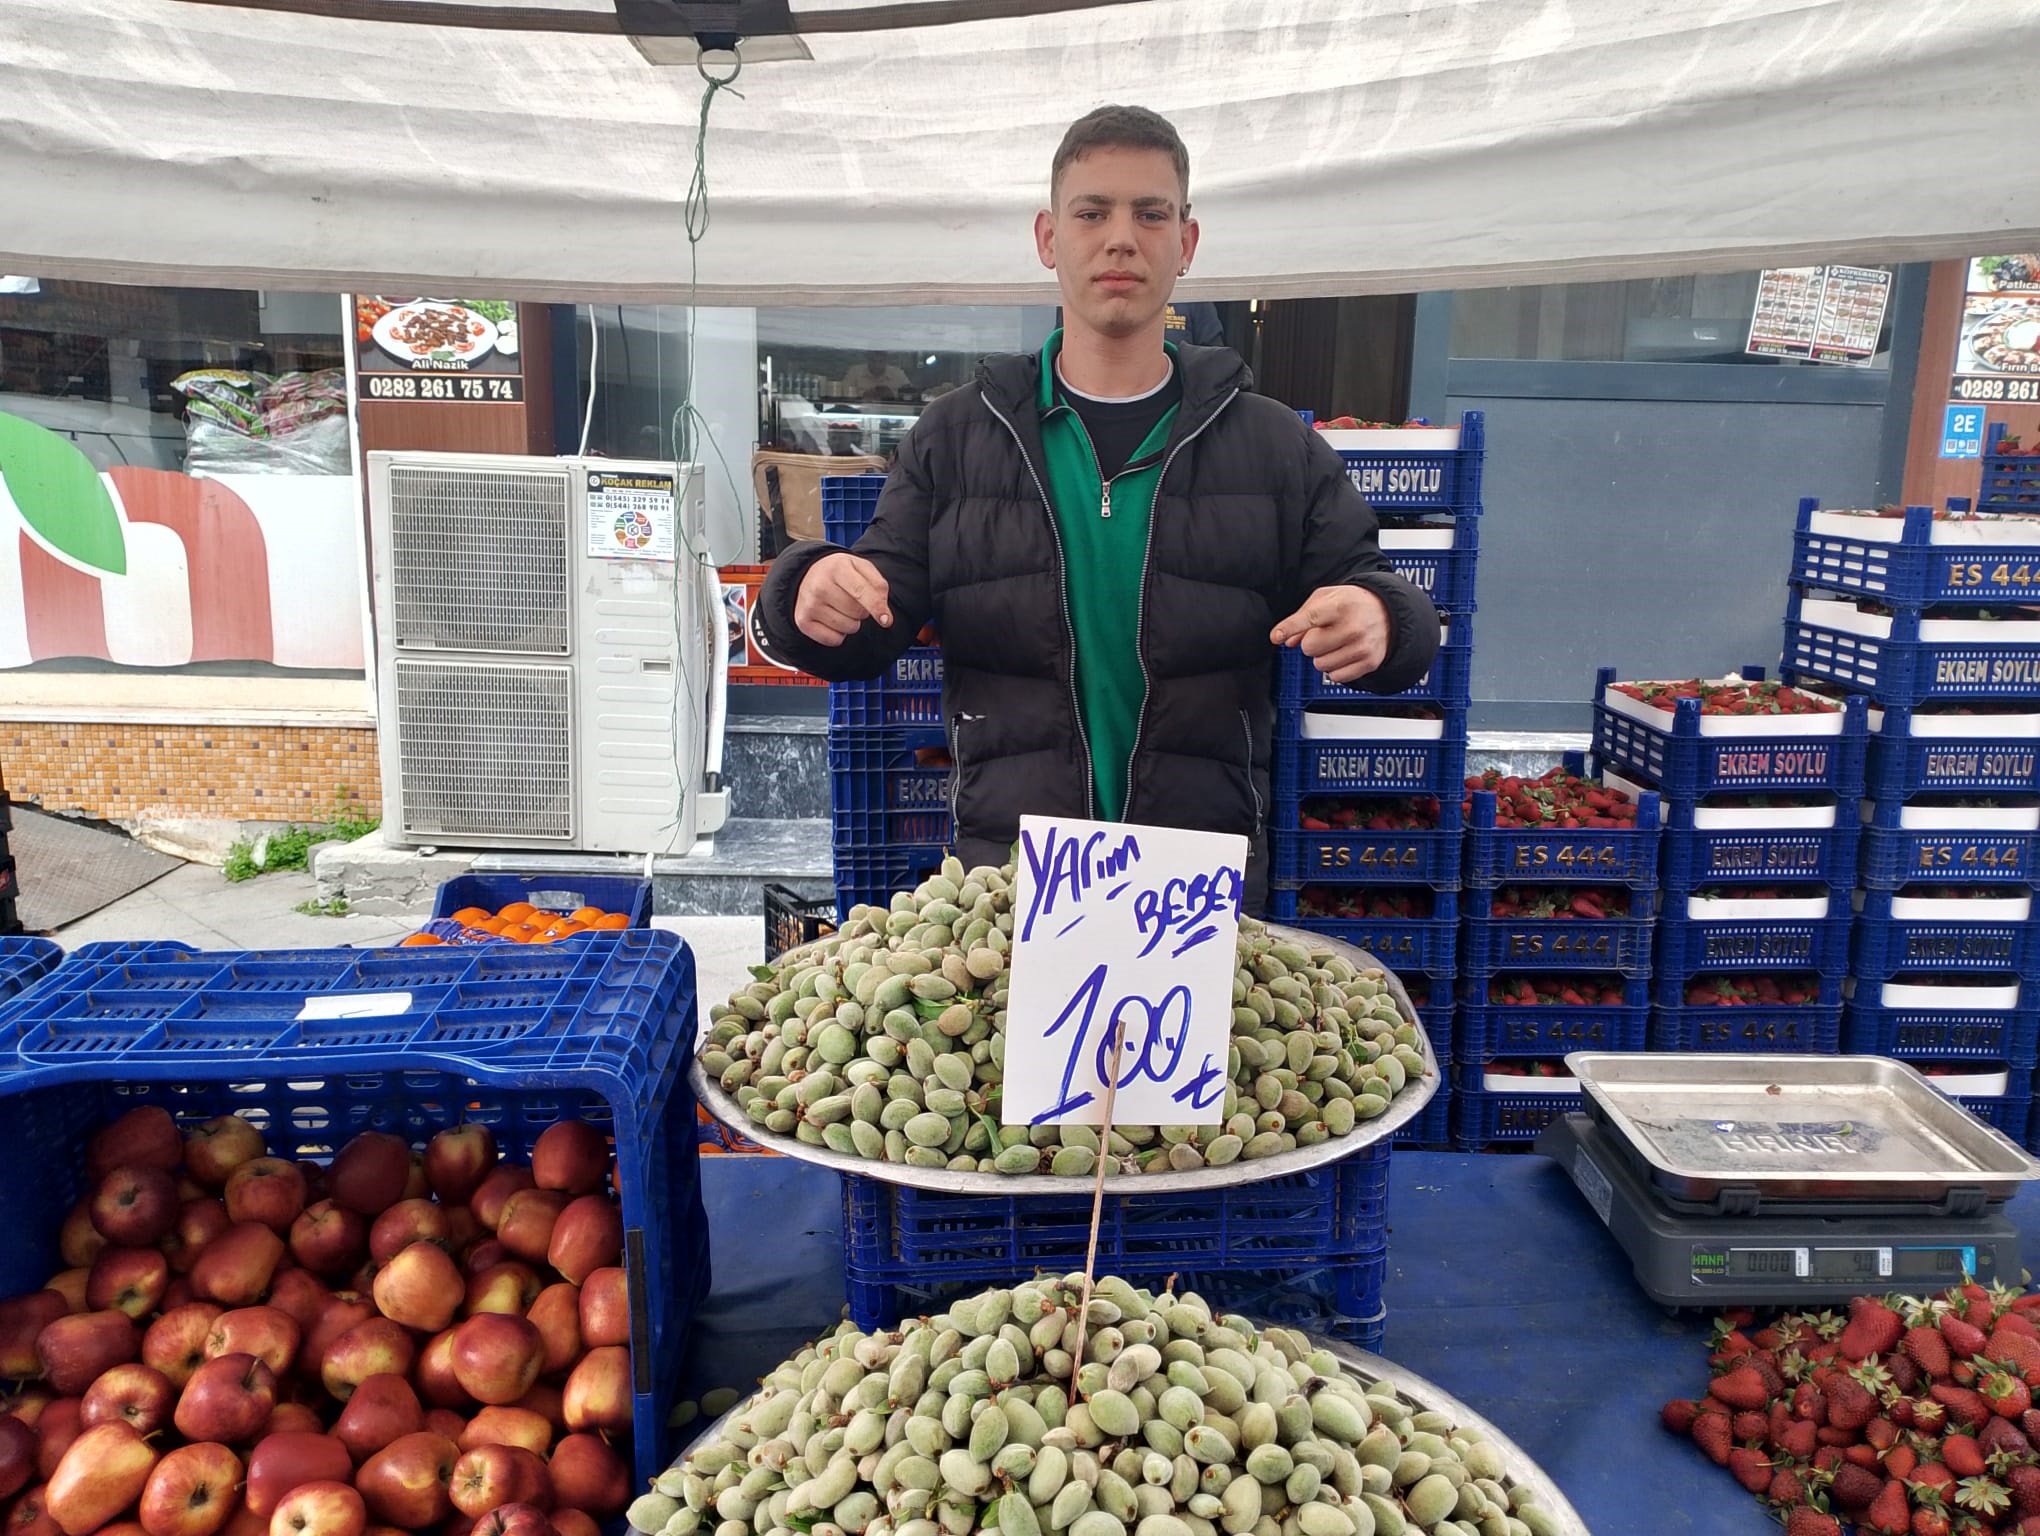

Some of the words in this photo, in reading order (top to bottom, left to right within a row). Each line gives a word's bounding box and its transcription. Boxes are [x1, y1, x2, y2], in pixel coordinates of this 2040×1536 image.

[1998, 279, 2040, 290] Patlıca
[411, 358, 430, 370] Ali
[434, 359, 470, 371] Nazik
[369, 377, 417, 398] 0282
[421, 378, 455, 399] 261
[460, 379, 485, 399] 75
[489, 380, 514, 400] 74
[1961, 379, 2004, 400] 0282
[2007, 380, 2040, 401] 261
[1953, 414, 1977, 433] 2E
[601, 477, 633, 489] KOÇAK
[634, 479, 672, 490] REKLAM
[1345, 468, 1384, 493] REM
[1386, 468, 1442, 493] SOYLU
[1948, 563, 1983, 587] ES
[896, 658, 945, 681] EKRE
[1935, 660, 1989, 684] EKREM
[1318, 756, 1370, 778] EKREM
[1373, 756, 1425, 778] SOYLU
[1718, 753, 1770, 776] EKREM
[1773, 752, 1827, 775] SOYLU
[1926, 754, 1979, 777] EKREM
[1981, 754, 2035, 777] SOYLU
[1318, 846, 1351, 868] ES
[1359, 846, 1419, 868] 444
[1515, 844, 1550, 868] ES
[1556, 845, 1617, 868] 444
[1712, 845, 1763, 868] EKREM
[1766, 845, 1820, 868] SOYLU
[1918, 846, 1953, 867] ES
[1960, 846, 2019, 868] 444
[1510, 934, 1544, 956] ES
[1551, 934, 1610, 956] 444
[1547, 1021, 1607, 1043] 444
[1029, 963, 1192, 1125] 100
[1692, 1254, 1724, 1266] HANA
